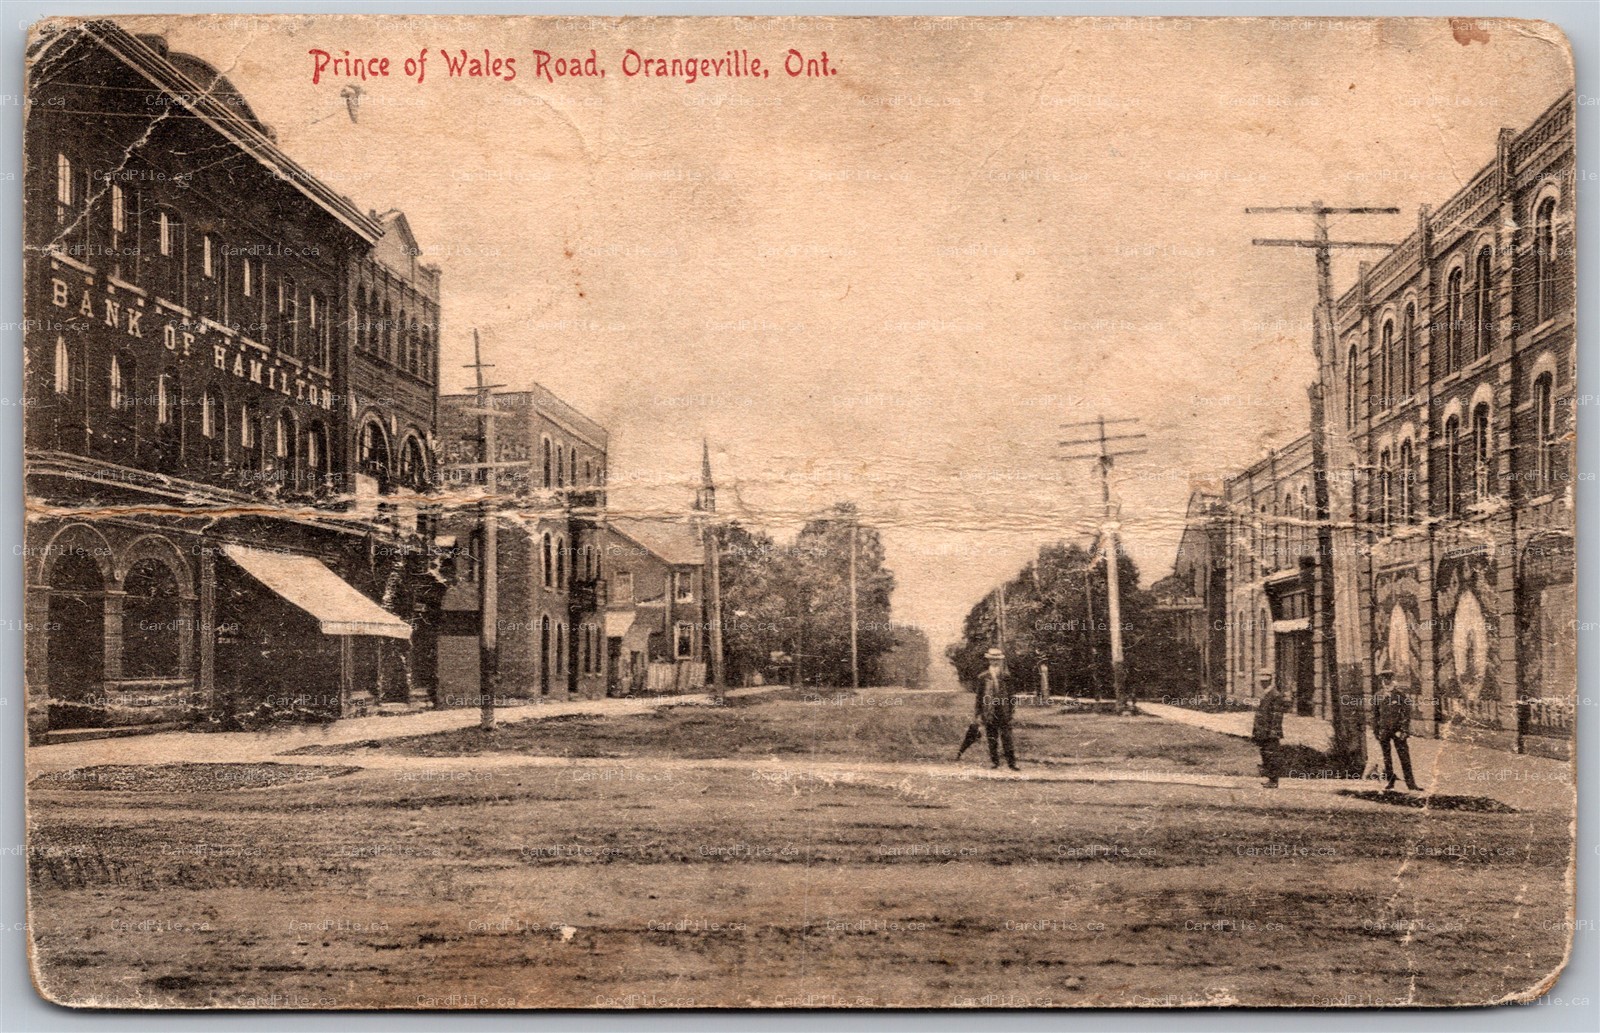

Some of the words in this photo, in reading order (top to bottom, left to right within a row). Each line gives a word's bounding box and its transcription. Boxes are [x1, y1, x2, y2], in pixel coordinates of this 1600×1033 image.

[50, 277, 143, 338] BANK
[163, 323, 196, 356] OF
[213, 344, 333, 410] HAMILTON
